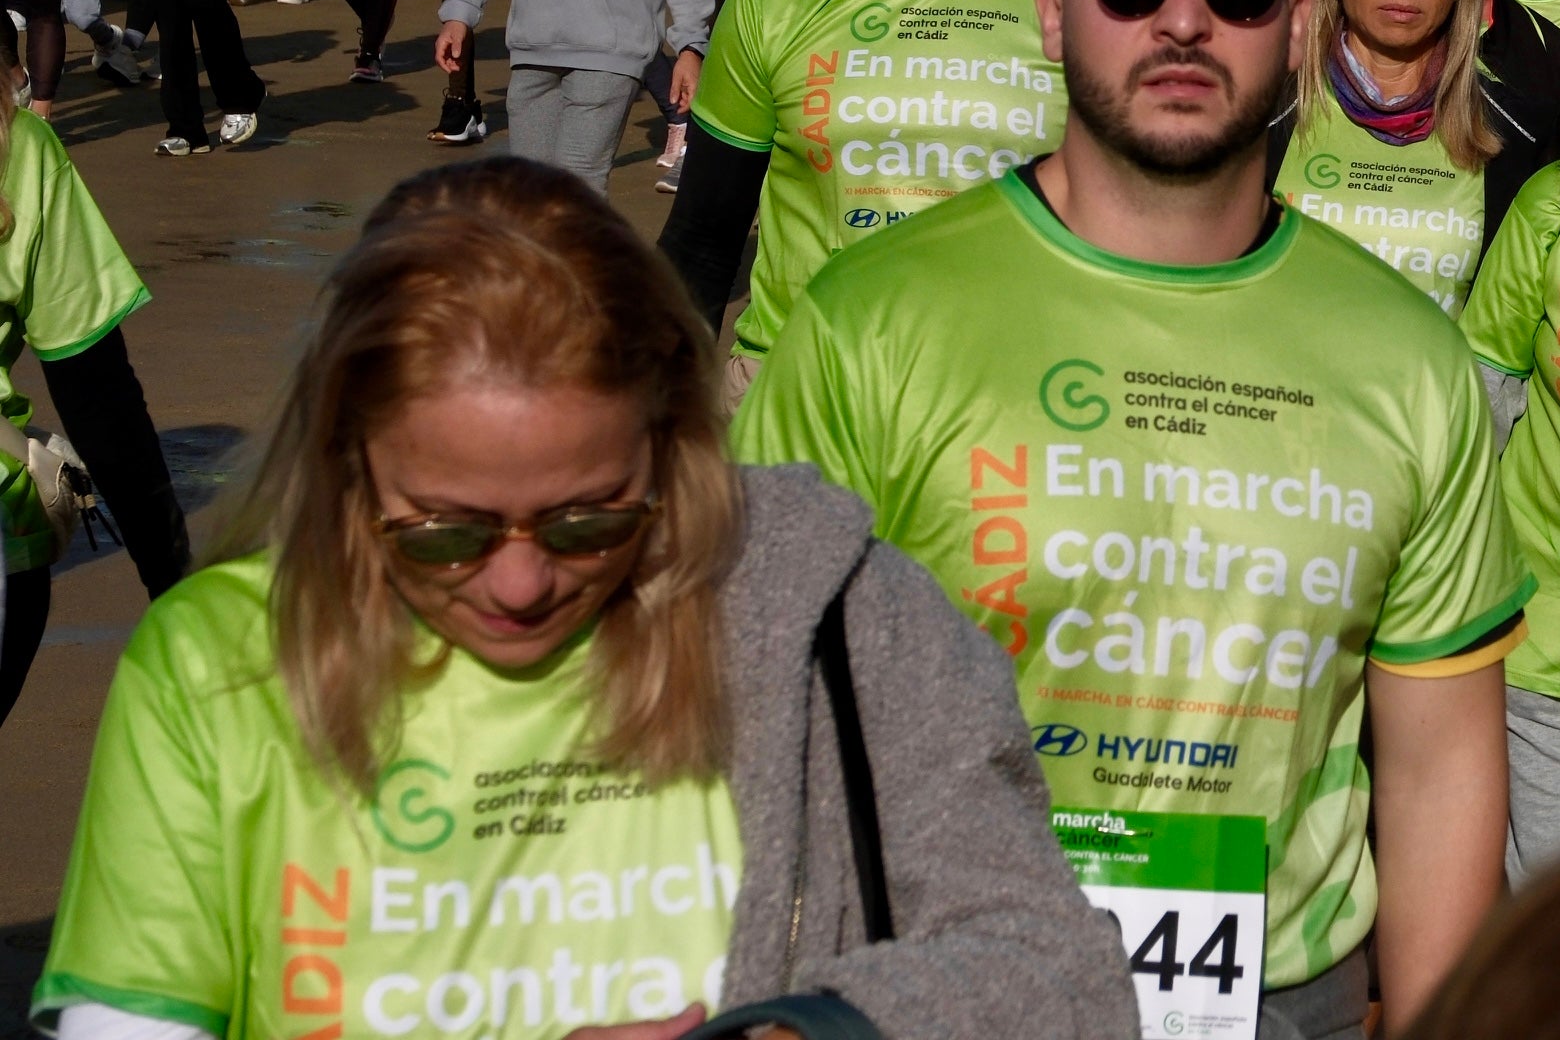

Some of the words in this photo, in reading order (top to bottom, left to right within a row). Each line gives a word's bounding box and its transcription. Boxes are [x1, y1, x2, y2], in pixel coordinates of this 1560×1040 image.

[899, 18, 938, 28] contra
[940, 18, 951, 28] el
[953, 18, 995, 31] cáncer
[901, 6, 964, 16] asociación
[966, 7, 1020, 24] española
[897, 31, 913, 39] en
[915, 29, 949, 40] Cádiz
[844, 49, 892, 78] En
[905, 56, 1052, 94] marcha
[797, 50, 839, 174] CÁDIZ
[837, 90, 997, 130] contra
[1006, 102, 1046, 140] el
[840, 128, 1033, 181] cánce
[1351, 161, 1406, 173] asociación
[1409, 166, 1456, 179] española
[855, 187, 890, 195] MARCHA
[893, 188, 905, 196] EN
[906, 187, 933, 197] CÁDIZ
[1348, 181, 1361, 189] en
[1363, 182, 1393, 193] Cádiz
[1349, 171, 1383, 182] contra
[1386, 173, 1396, 182] el
[1397, 174, 1434, 185] cáncer
[1301, 193, 1344, 224] En
[1354, 205, 1479, 241] marcha
[1437, 249, 1470, 282] el
[1124, 368, 1227, 393] asociación
[1231, 381, 1314, 408] española
[1124, 391, 1187, 413] contra
[1191, 395, 1209, 413] el
[1212, 398, 1277, 423] cáncer
[1124, 415, 1148, 429] en
[1152, 413, 1207, 436] Cádiz
[1045, 444, 1124, 498] En
[1145, 462, 1374, 532] marcha
[1044, 528, 1286, 597] contra
[1301, 546, 1357, 610] el
[1044, 592, 1337, 690] cáncer
[1053, 689, 1112, 705] MARCHA
[1116, 694, 1132, 707] EN
[1097, 733, 1238, 769] HYUNDAI
[573, 780, 652, 803] cánce
[1093, 766, 1182, 789] Guadalete
[1187, 776, 1232, 794] Motor
[473, 822, 504, 839] en
[1053, 812, 1126, 830] marcha
[1101, 852, 1111, 861] EL
[370, 866, 470, 933] En
[493, 842, 739, 927] march
[281, 864, 350, 1040] DIZ
[1109, 910, 1244, 995] 44
[363, 947, 683, 1036] contra
